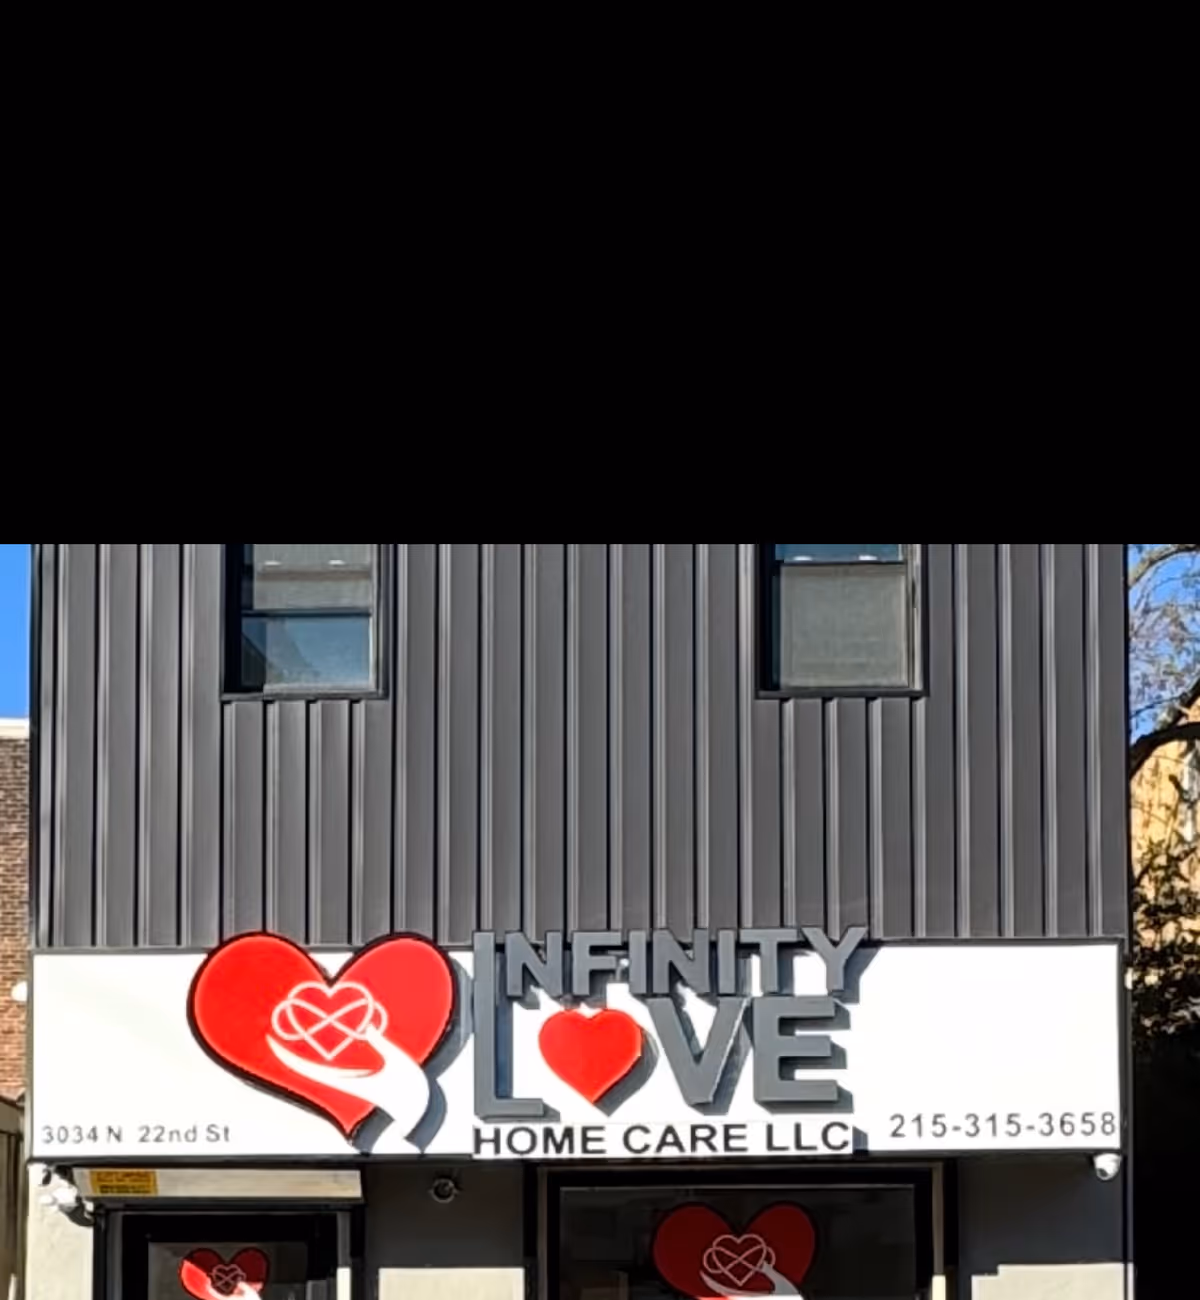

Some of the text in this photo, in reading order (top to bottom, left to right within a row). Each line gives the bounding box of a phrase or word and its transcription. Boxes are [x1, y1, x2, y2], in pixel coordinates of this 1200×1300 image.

[473, 926, 869, 998] INFINITY
[41, 1124, 230, 1144] 3034 N 22nd St
[473, 1121, 850, 1155] HOME CARE LLC
[889, 1112, 1116, 1138] 215-315-3658
